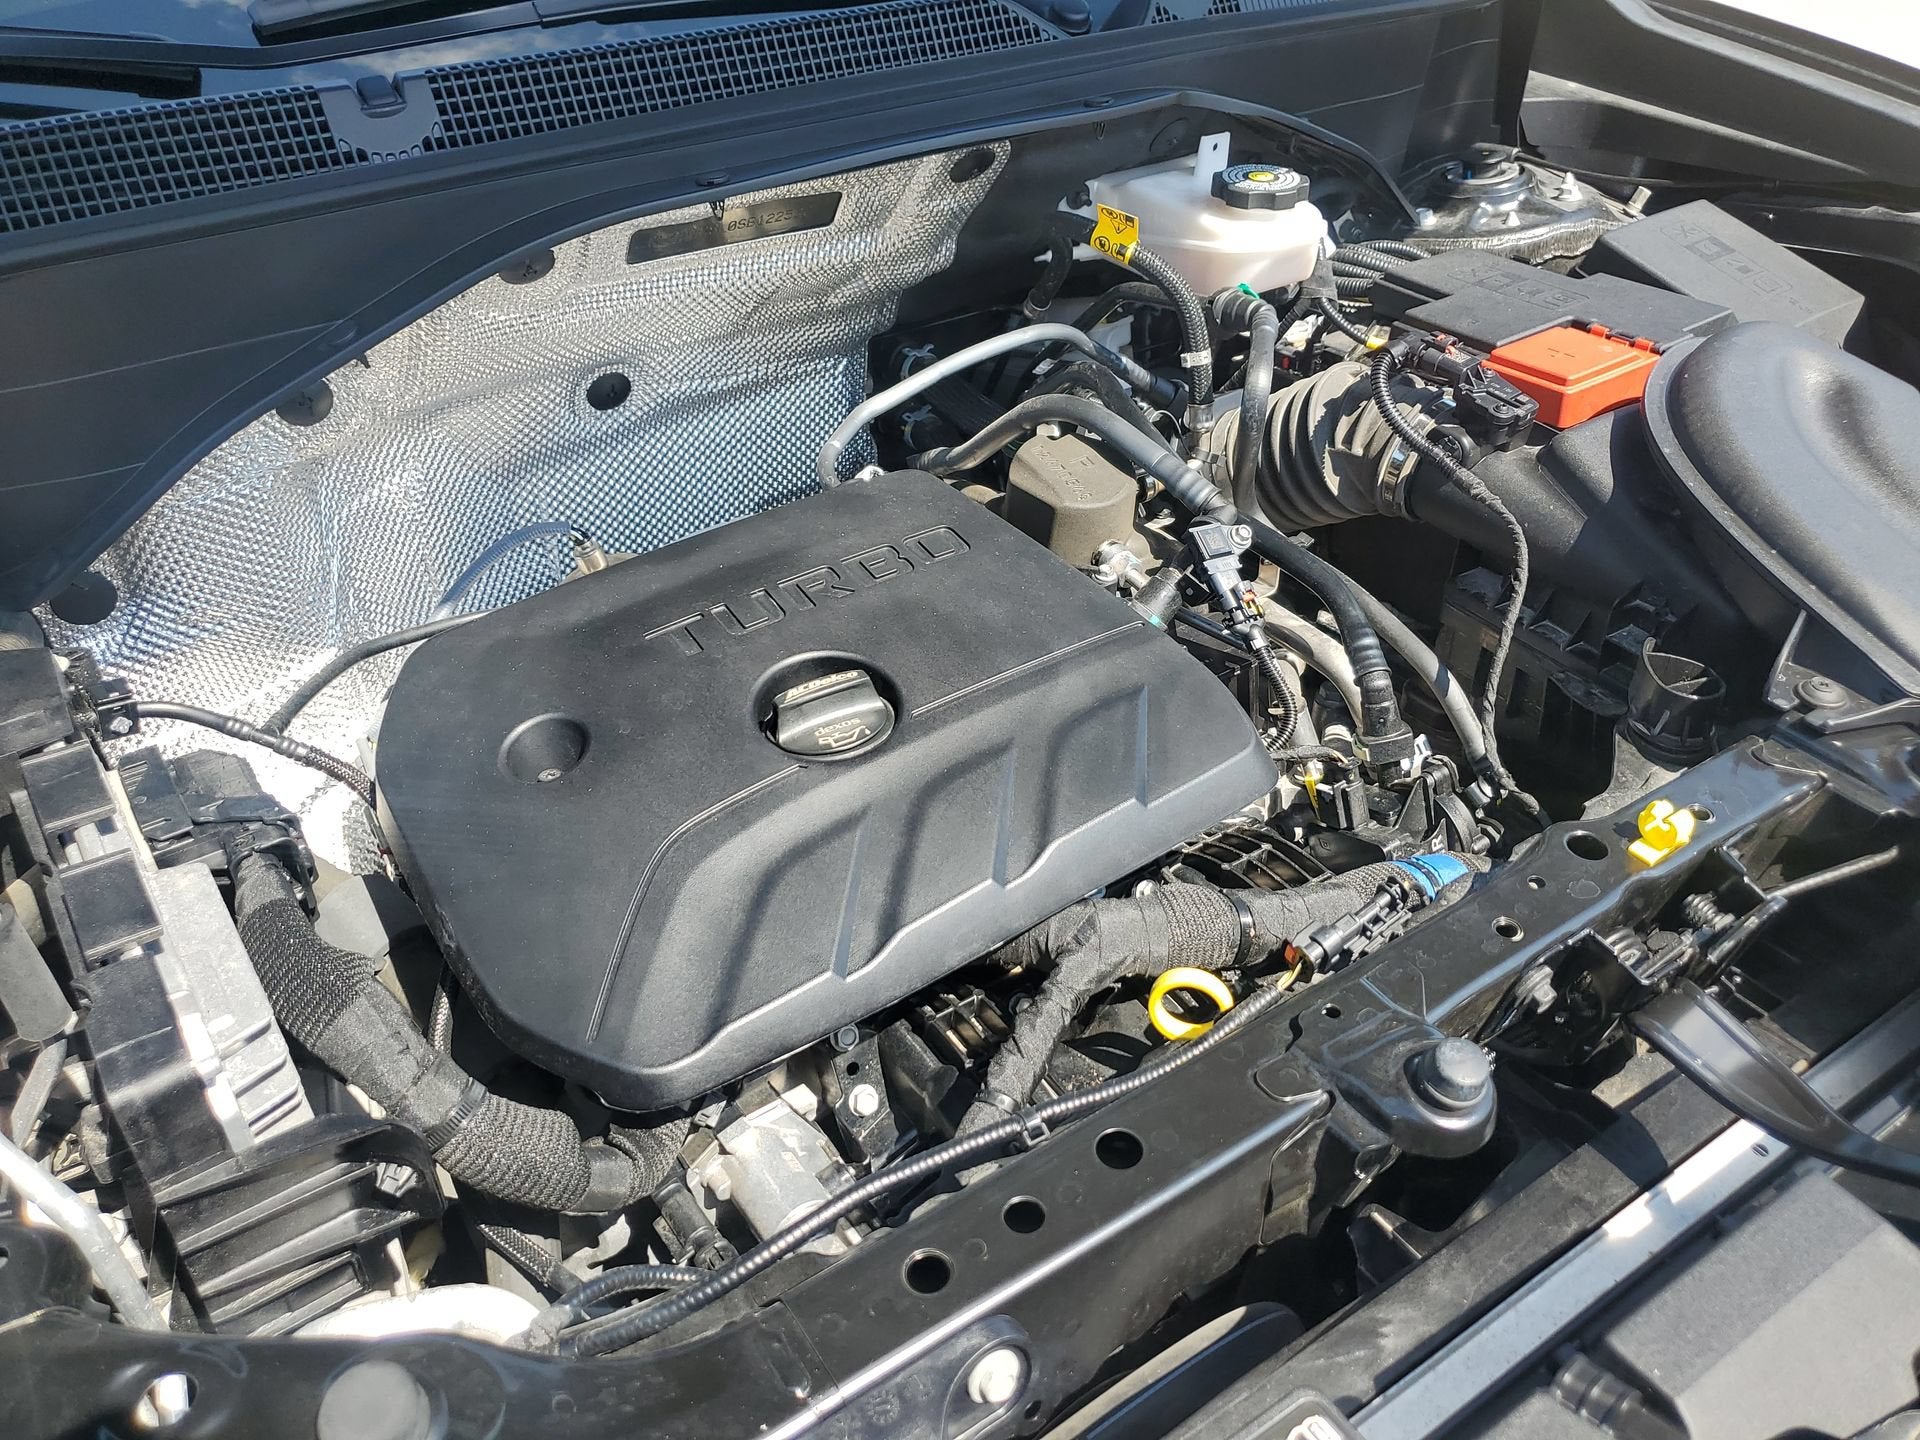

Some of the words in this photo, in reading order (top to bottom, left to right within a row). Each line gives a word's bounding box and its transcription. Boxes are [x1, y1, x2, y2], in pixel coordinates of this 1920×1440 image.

[643, 525, 972, 657] TURBO
[785, 671, 859, 701] ACDelco
[814, 717, 861, 736] dexos
